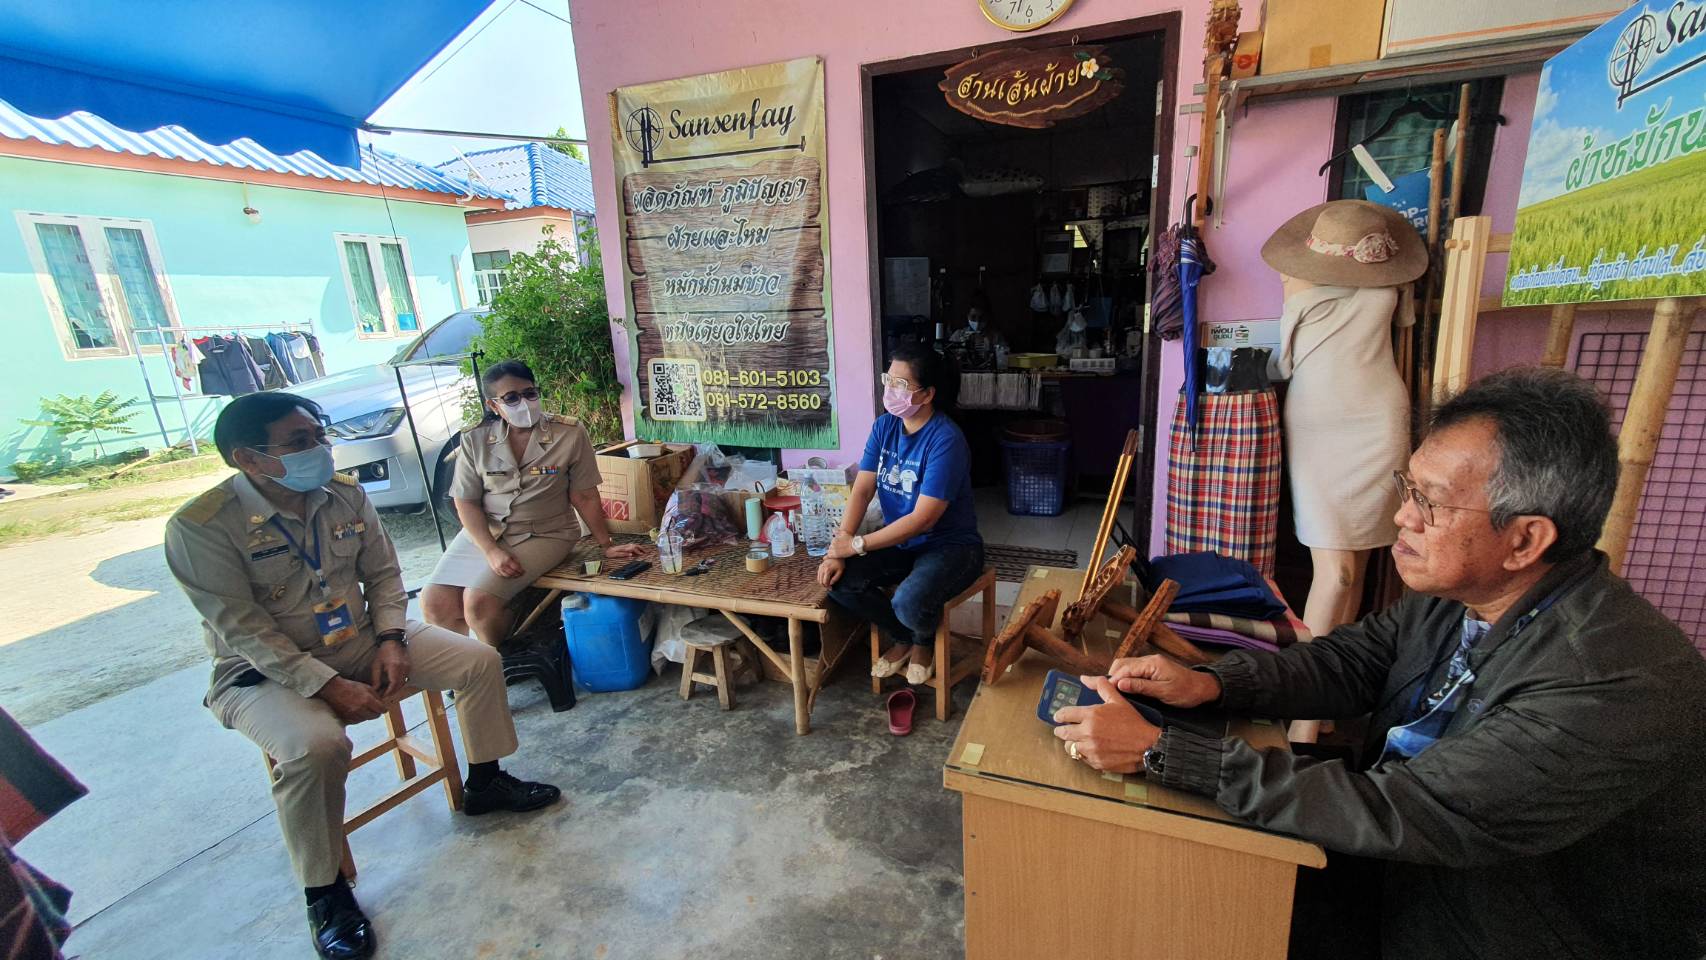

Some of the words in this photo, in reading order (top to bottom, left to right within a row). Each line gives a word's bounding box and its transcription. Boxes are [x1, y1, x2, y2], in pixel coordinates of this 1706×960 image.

[1656, 1, 1706, 54] Sa
[958, 62, 1081, 105] สานเส้นฝ้าย
[668, 98, 796, 140] Sansenfay
[633, 180, 723, 213] ผลิตภัณฑ์
[720, 176, 808, 213] ภูมิปัญญา
[667, 218, 773, 250] ฝ้ายและไหม
[665, 262, 780, 296] หมักน้ำนมข้าว
[665, 312, 787, 345] หนึ่งเดียวในไทย
[703, 370, 820, 386] 081-601-5103
[707, 393, 821, 410] 081-572-8560
